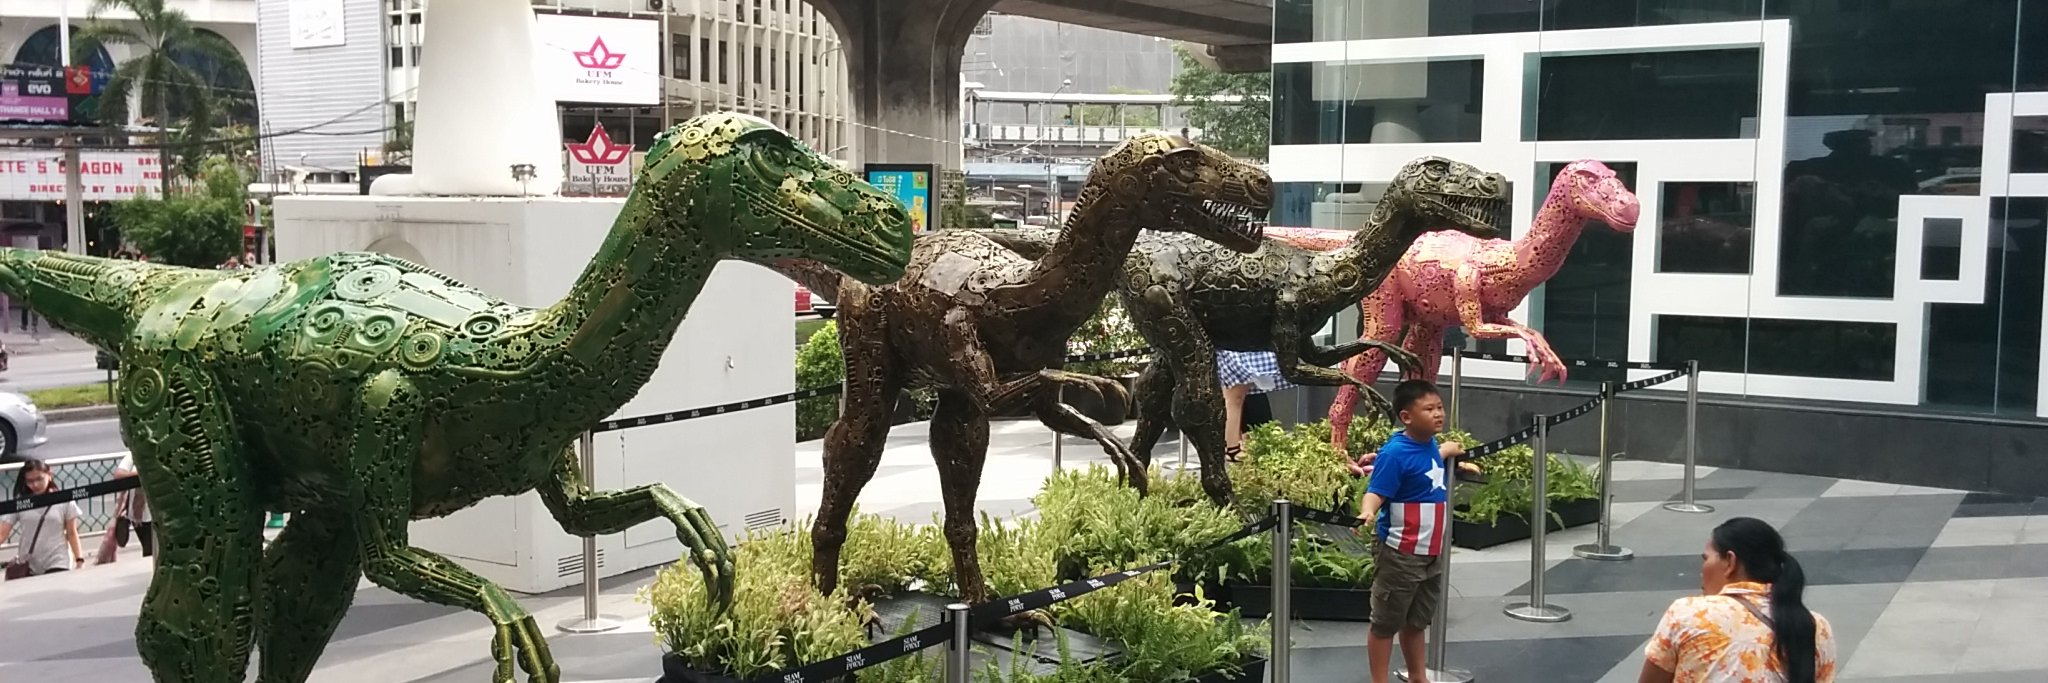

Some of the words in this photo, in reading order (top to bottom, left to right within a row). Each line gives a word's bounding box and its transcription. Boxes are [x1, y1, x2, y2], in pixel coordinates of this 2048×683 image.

[58, 160, 123, 174] DAGON
[585, 165, 614, 174] UFM
[572, 175, 601, 183] Bakey
[92, 185, 104, 193] BY
[846, 653, 861, 663] SIAM
[783, 671, 800, 683] SIAM
